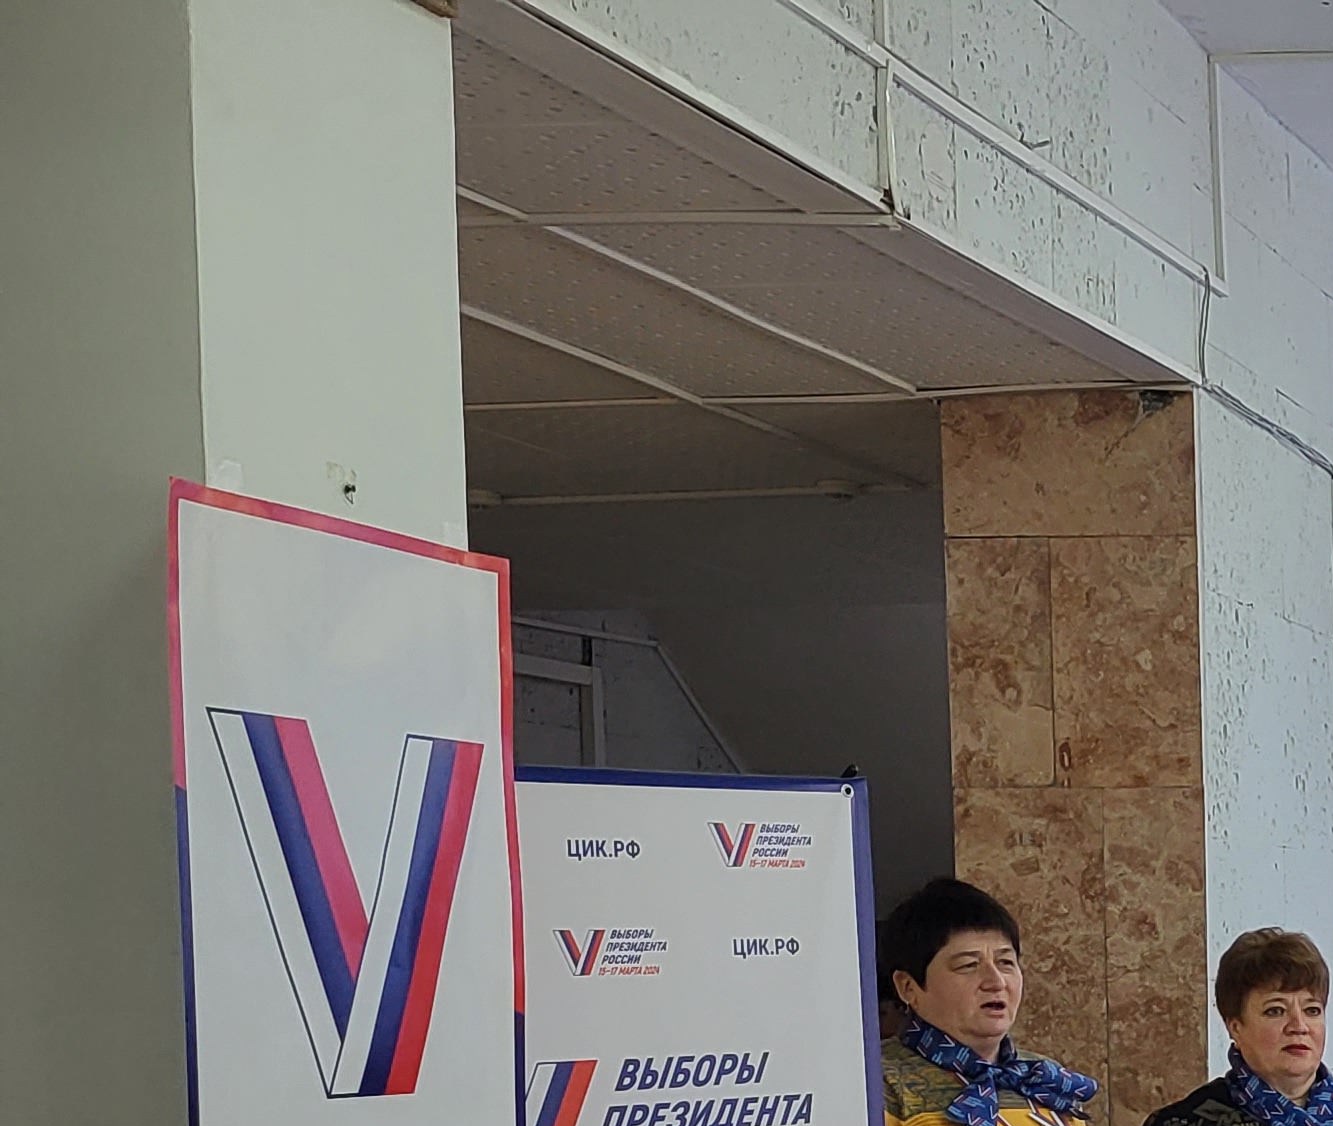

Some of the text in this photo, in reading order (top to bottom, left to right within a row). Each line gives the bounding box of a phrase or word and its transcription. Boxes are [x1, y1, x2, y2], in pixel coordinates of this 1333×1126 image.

[760, 824, 799, 833] ВЫБОРЫ
[756, 836, 812, 846] ПРЕЗИДЕНТА
[567, 840, 640, 861] ЦИК.РФ
[752, 848, 788, 857] РОССИИ
[610, 929, 654, 939] ВЫБОРЫ
[606, 942, 667, 952] ПРЕЗИДЕНТА
[734, 938, 799, 959] ЦИК.РФ
[601, 955, 641, 965] РОССИИ
[618, 967, 641, 975] МАРТА
[615, 1052, 769, 1091] ВЫБОРЫ
